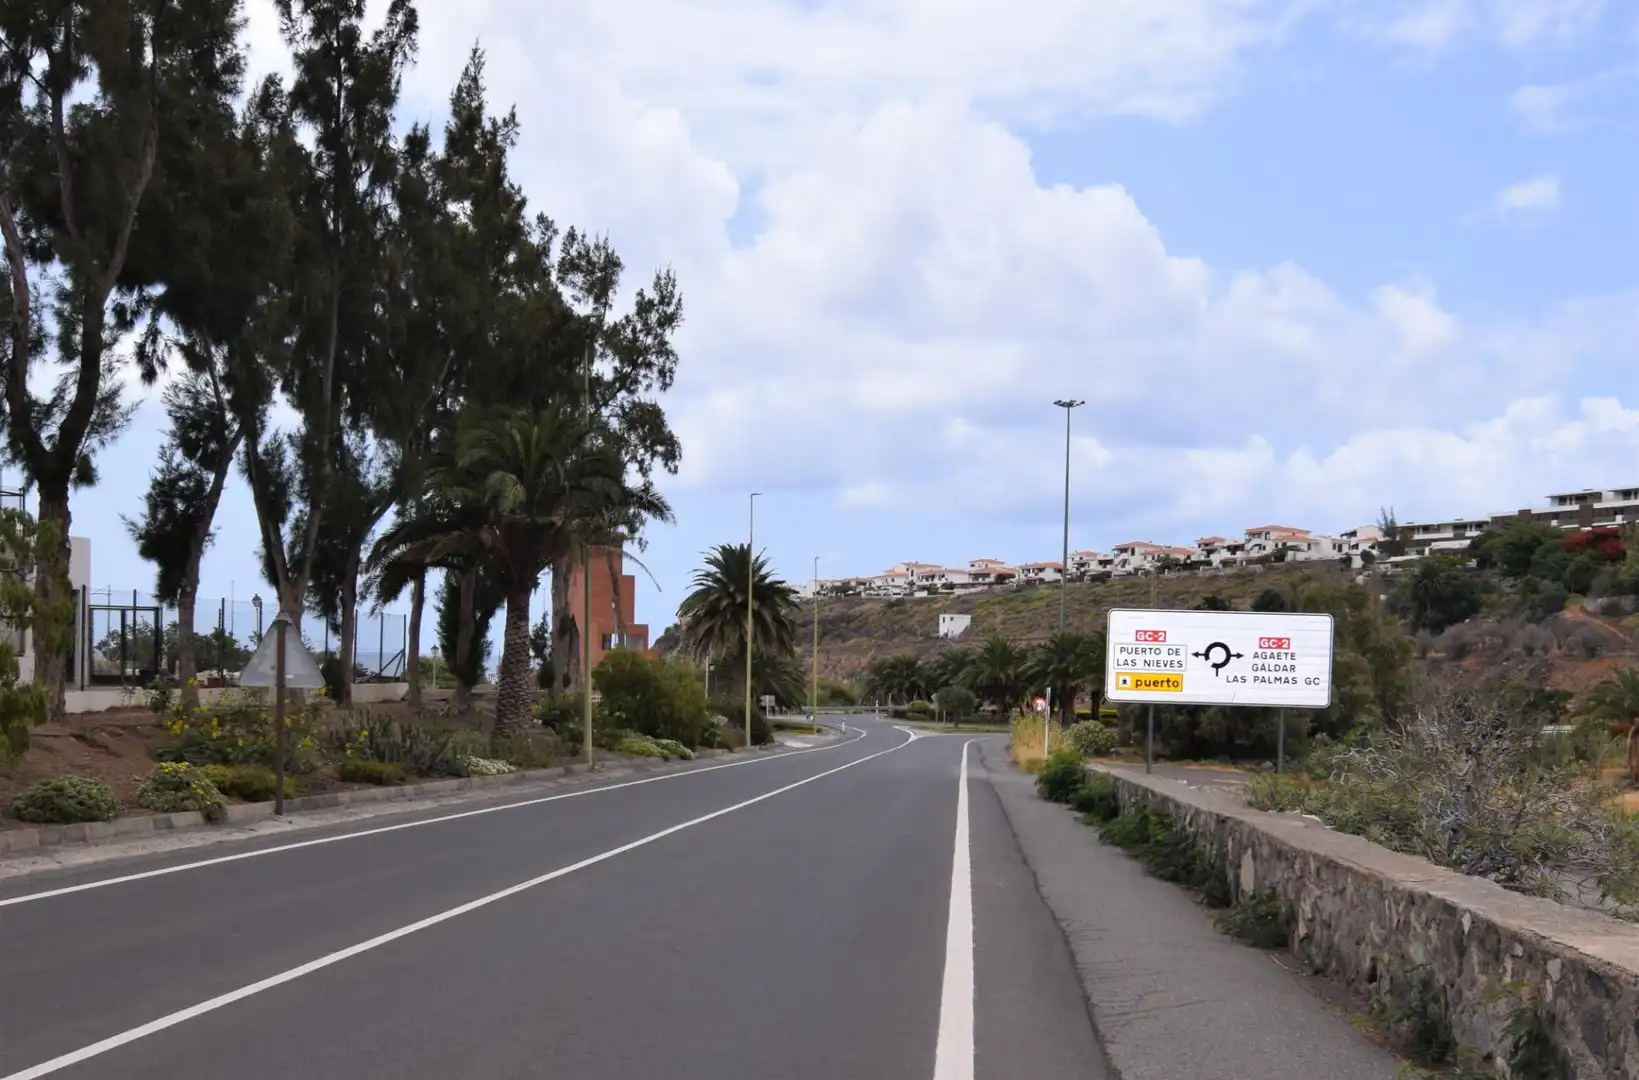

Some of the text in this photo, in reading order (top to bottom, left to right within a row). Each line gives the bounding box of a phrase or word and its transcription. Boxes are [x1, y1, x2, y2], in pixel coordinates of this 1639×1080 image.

[1137, 631, 1165, 641] GC-2
[1260, 638, 1289, 648] GC-2
[1120, 646, 1162, 656] PUERTO
[1253, 652, 1296, 660] AGAETE
[1116, 658, 1183, 668] LAS NIEVES
[1135, 678, 1180, 688] puerto
[1254, 676, 1298, 684] PALMAS
[1304, 678, 1320, 686] GC
